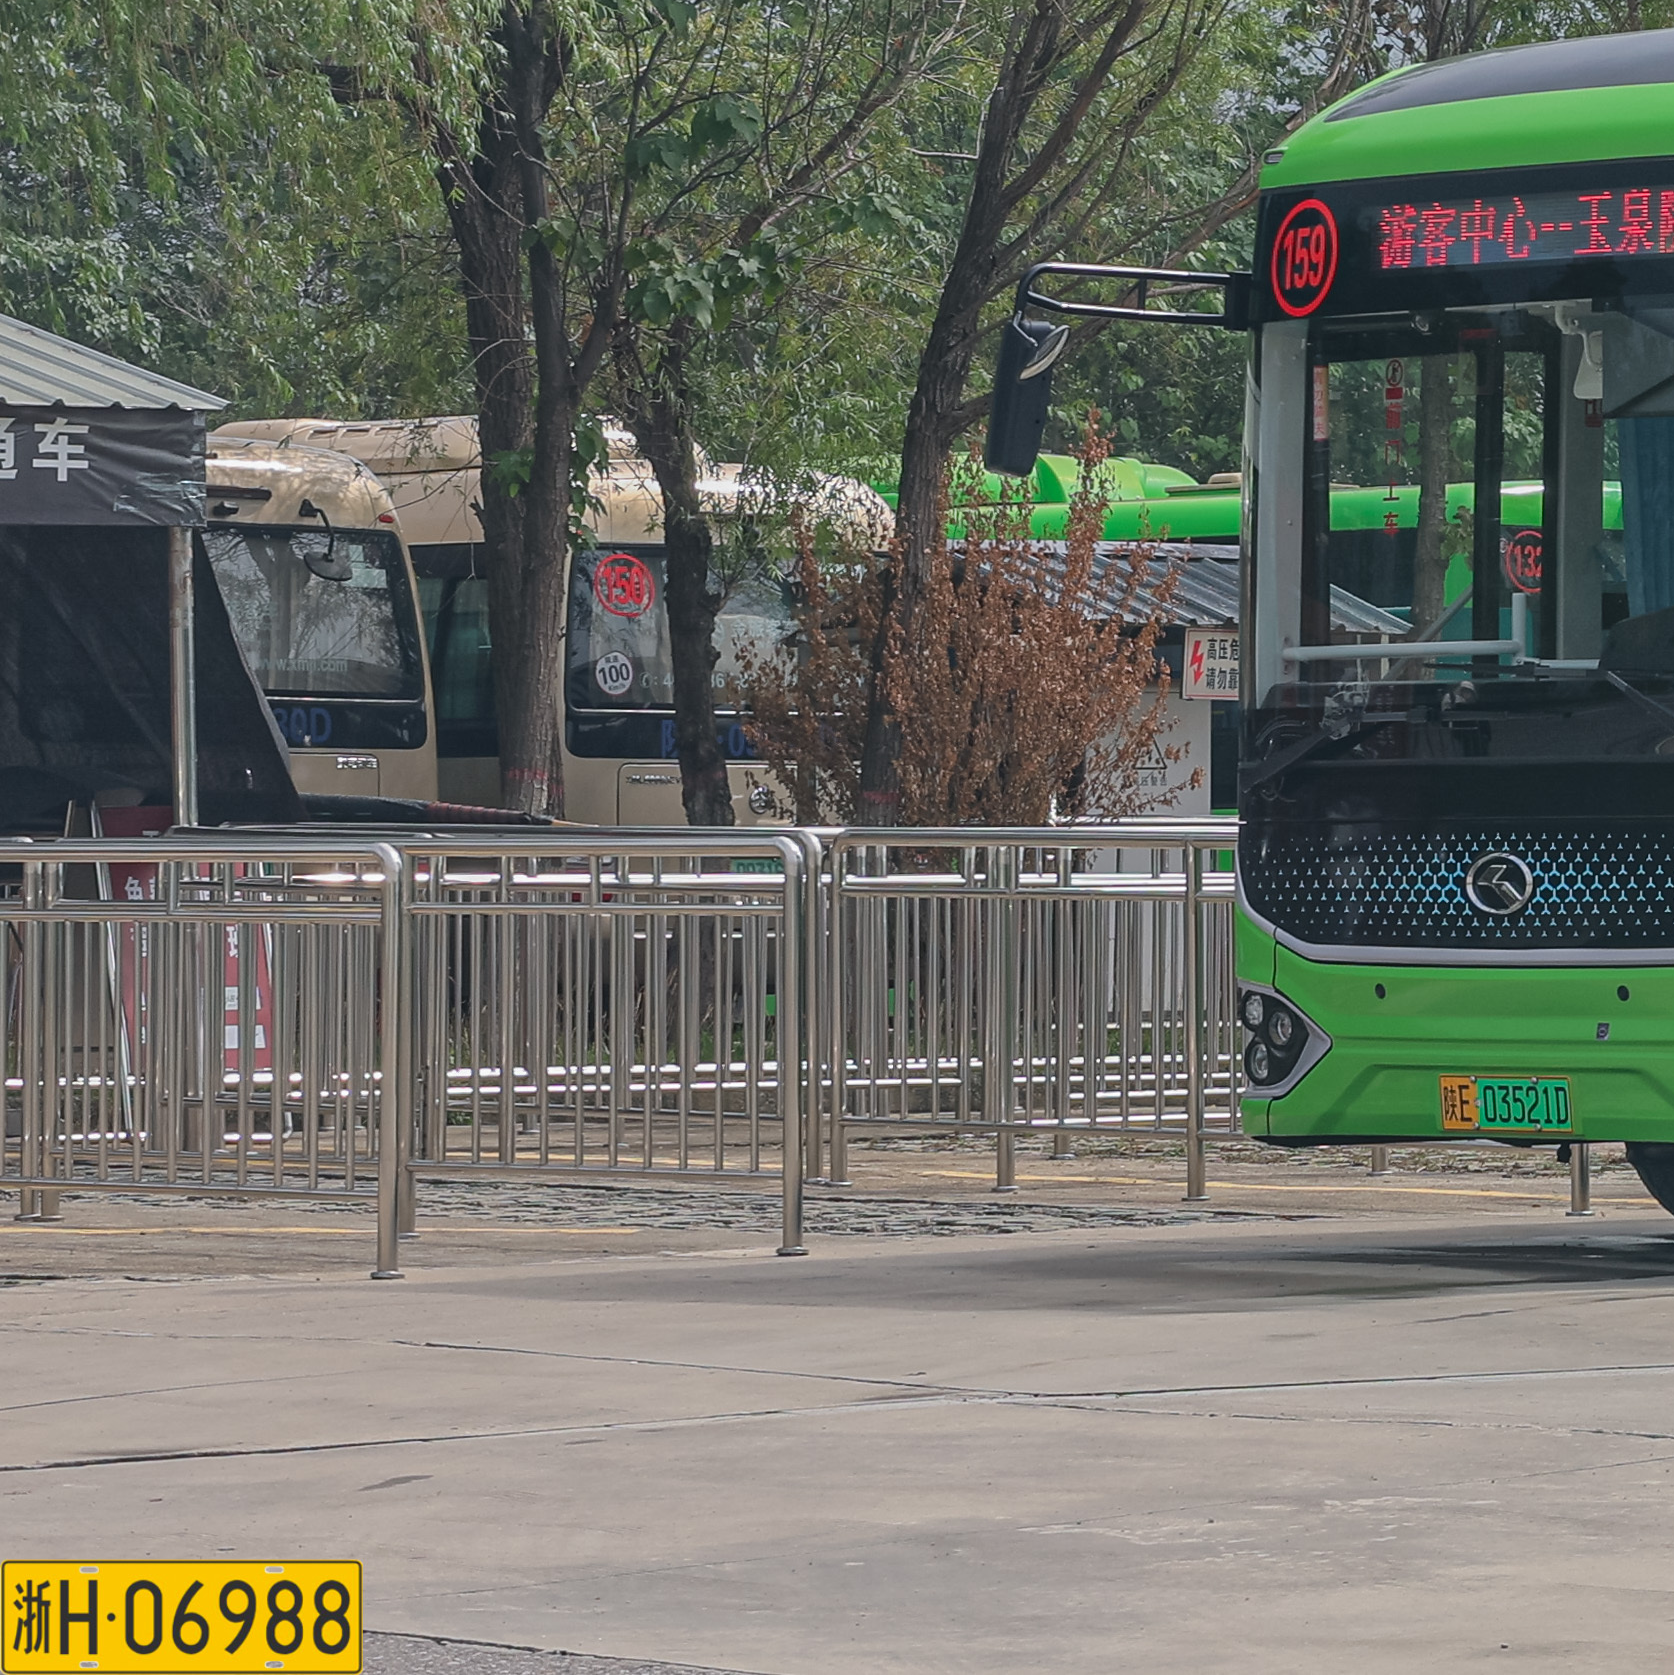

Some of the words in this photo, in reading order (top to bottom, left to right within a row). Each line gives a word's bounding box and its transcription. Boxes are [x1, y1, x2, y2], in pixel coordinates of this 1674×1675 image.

[1282, 223, 1326, 291] 159
[602, 565, 645, 605] 150
[598, 662, 630, 685] 100
